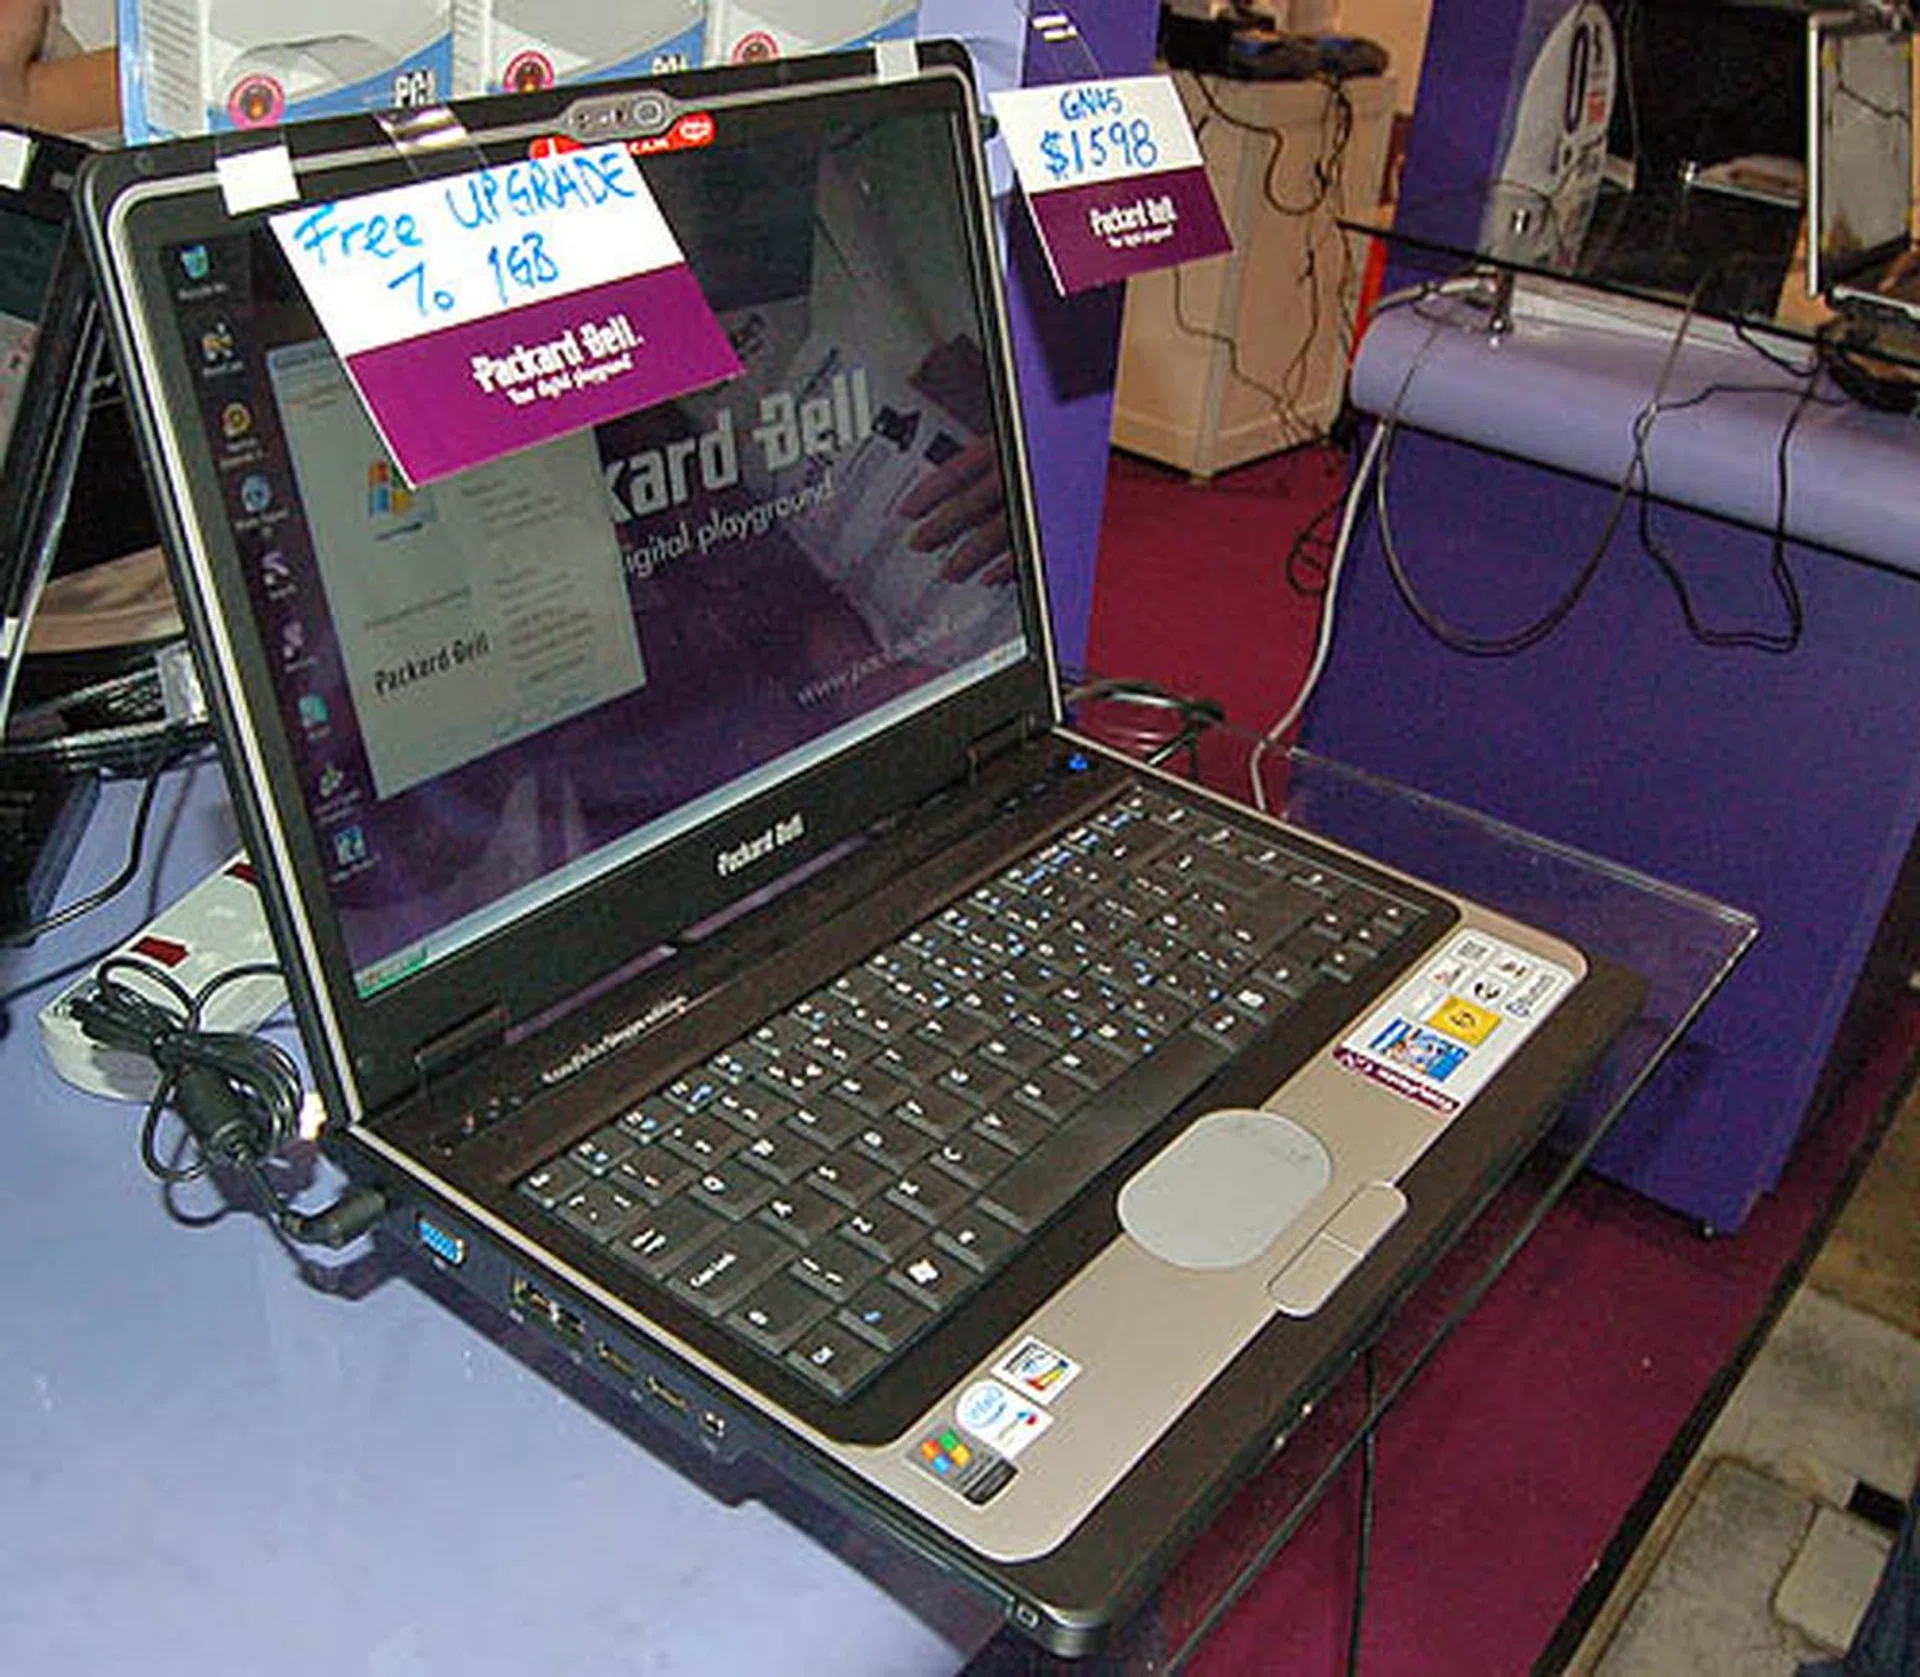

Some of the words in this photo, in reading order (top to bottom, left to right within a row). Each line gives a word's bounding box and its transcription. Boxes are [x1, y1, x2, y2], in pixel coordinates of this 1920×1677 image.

[1039, 118, 1158, 179] $1598
[293, 202, 424, 264] Free
[446, 153, 637, 229] UPGRADE
[387, 261, 455, 316] To
[488, 232, 560, 305] 1GB
[470, 329, 585, 394] Packard
[604, 408, 739, 524] kard
[752, 367, 873, 472] Bell
[625, 521, 690, 578] igital
[696, 469, 835, 555] playground
[373, 646, 450, 696] Packard
[717, 828, 774, 877] Packard
